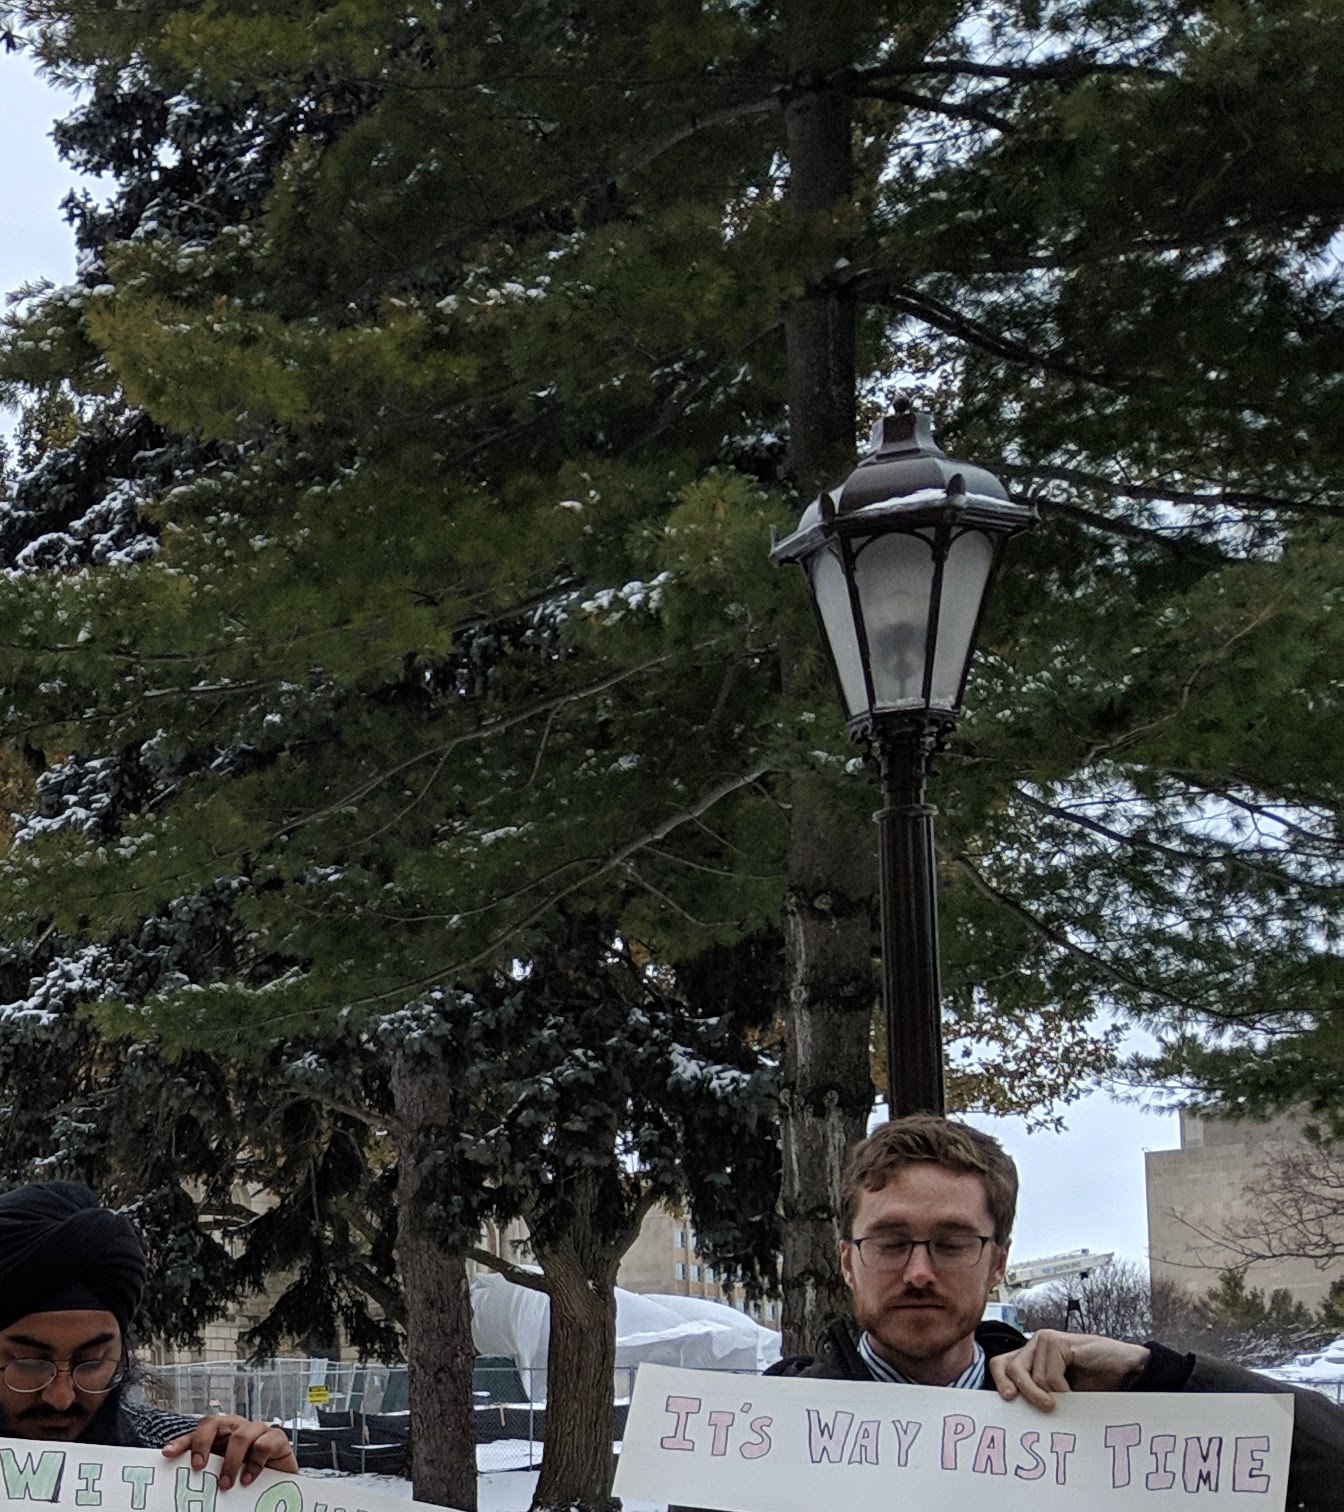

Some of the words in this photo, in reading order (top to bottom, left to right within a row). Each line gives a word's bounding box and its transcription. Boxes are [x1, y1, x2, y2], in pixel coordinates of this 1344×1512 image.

[659, 1395, 773, 1460] IT'S
[806, 1408, 921, 1468] WAY
[940, 1414, 1075, 1485] PAST
[1104, 1422, 1271, 1494] TIME
